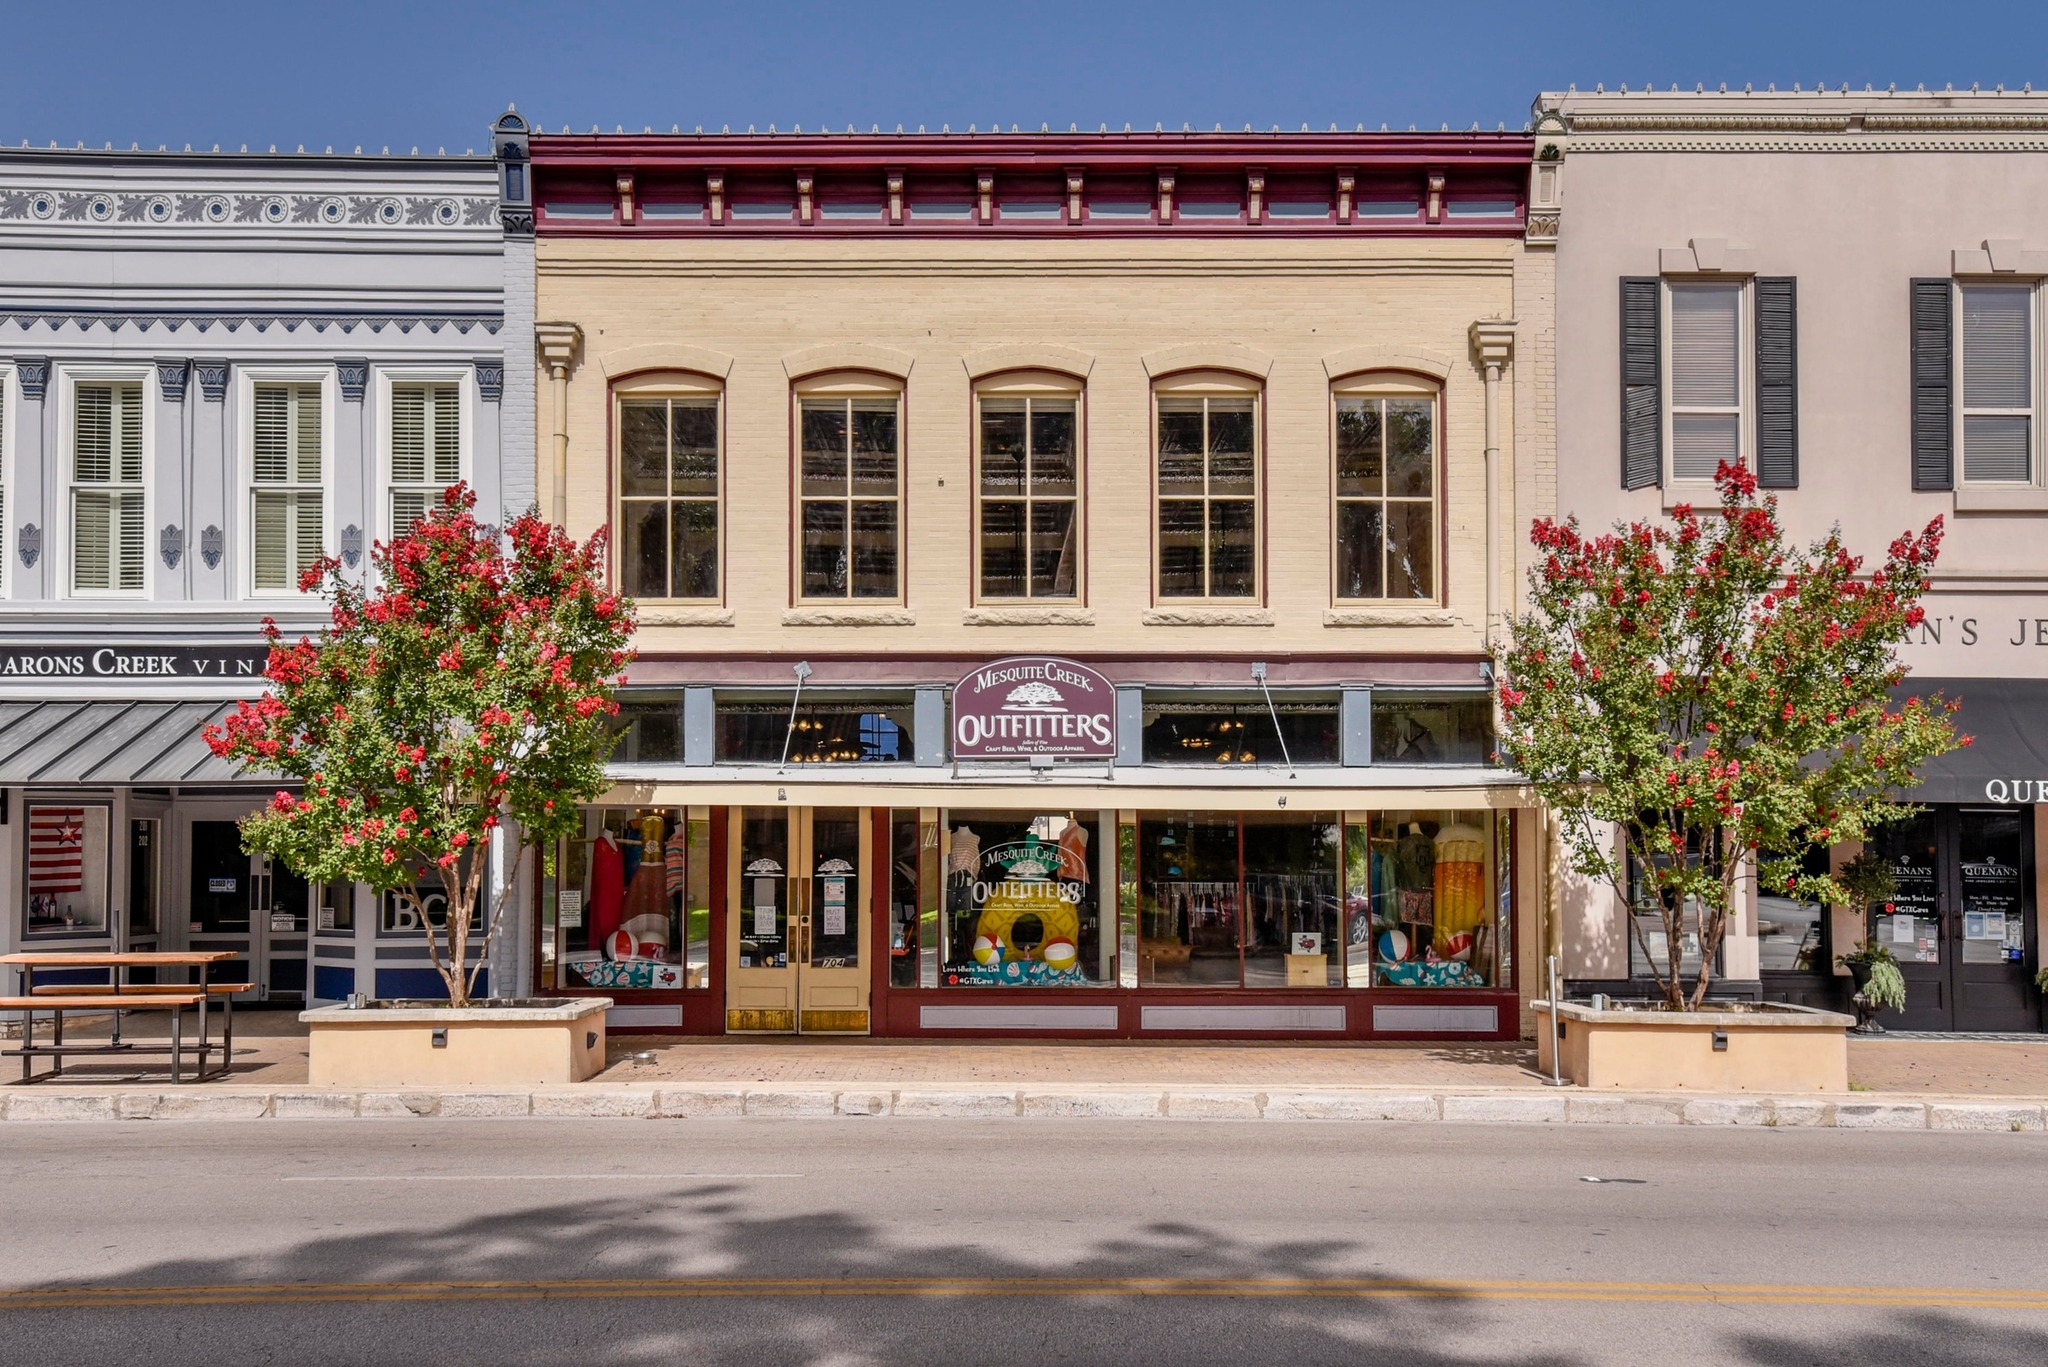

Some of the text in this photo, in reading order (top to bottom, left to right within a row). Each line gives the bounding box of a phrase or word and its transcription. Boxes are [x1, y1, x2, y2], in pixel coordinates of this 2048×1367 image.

[0, 656, 84, 674] ARONS
[92, 648, 177, 675] CREEK
[974, 662, 1094, 693] MESQUITE CREEK
[958, 714, 1112, 746] OUTFITTERS
[985, 846, 1069, 867] MESQUITE CREEK
[1890, 867, 1932, 875] ENAN'S
[1965, 867, 2018, 876] QUENAN'S
[972, 881, 1081, 904] OUTFITTERS
[1893, 894, 1911, 902] Where
[1912, 894, 1922, 902] You
[1923, 894, 1935, 902] Live
[824, 958, 844, 967] 704
